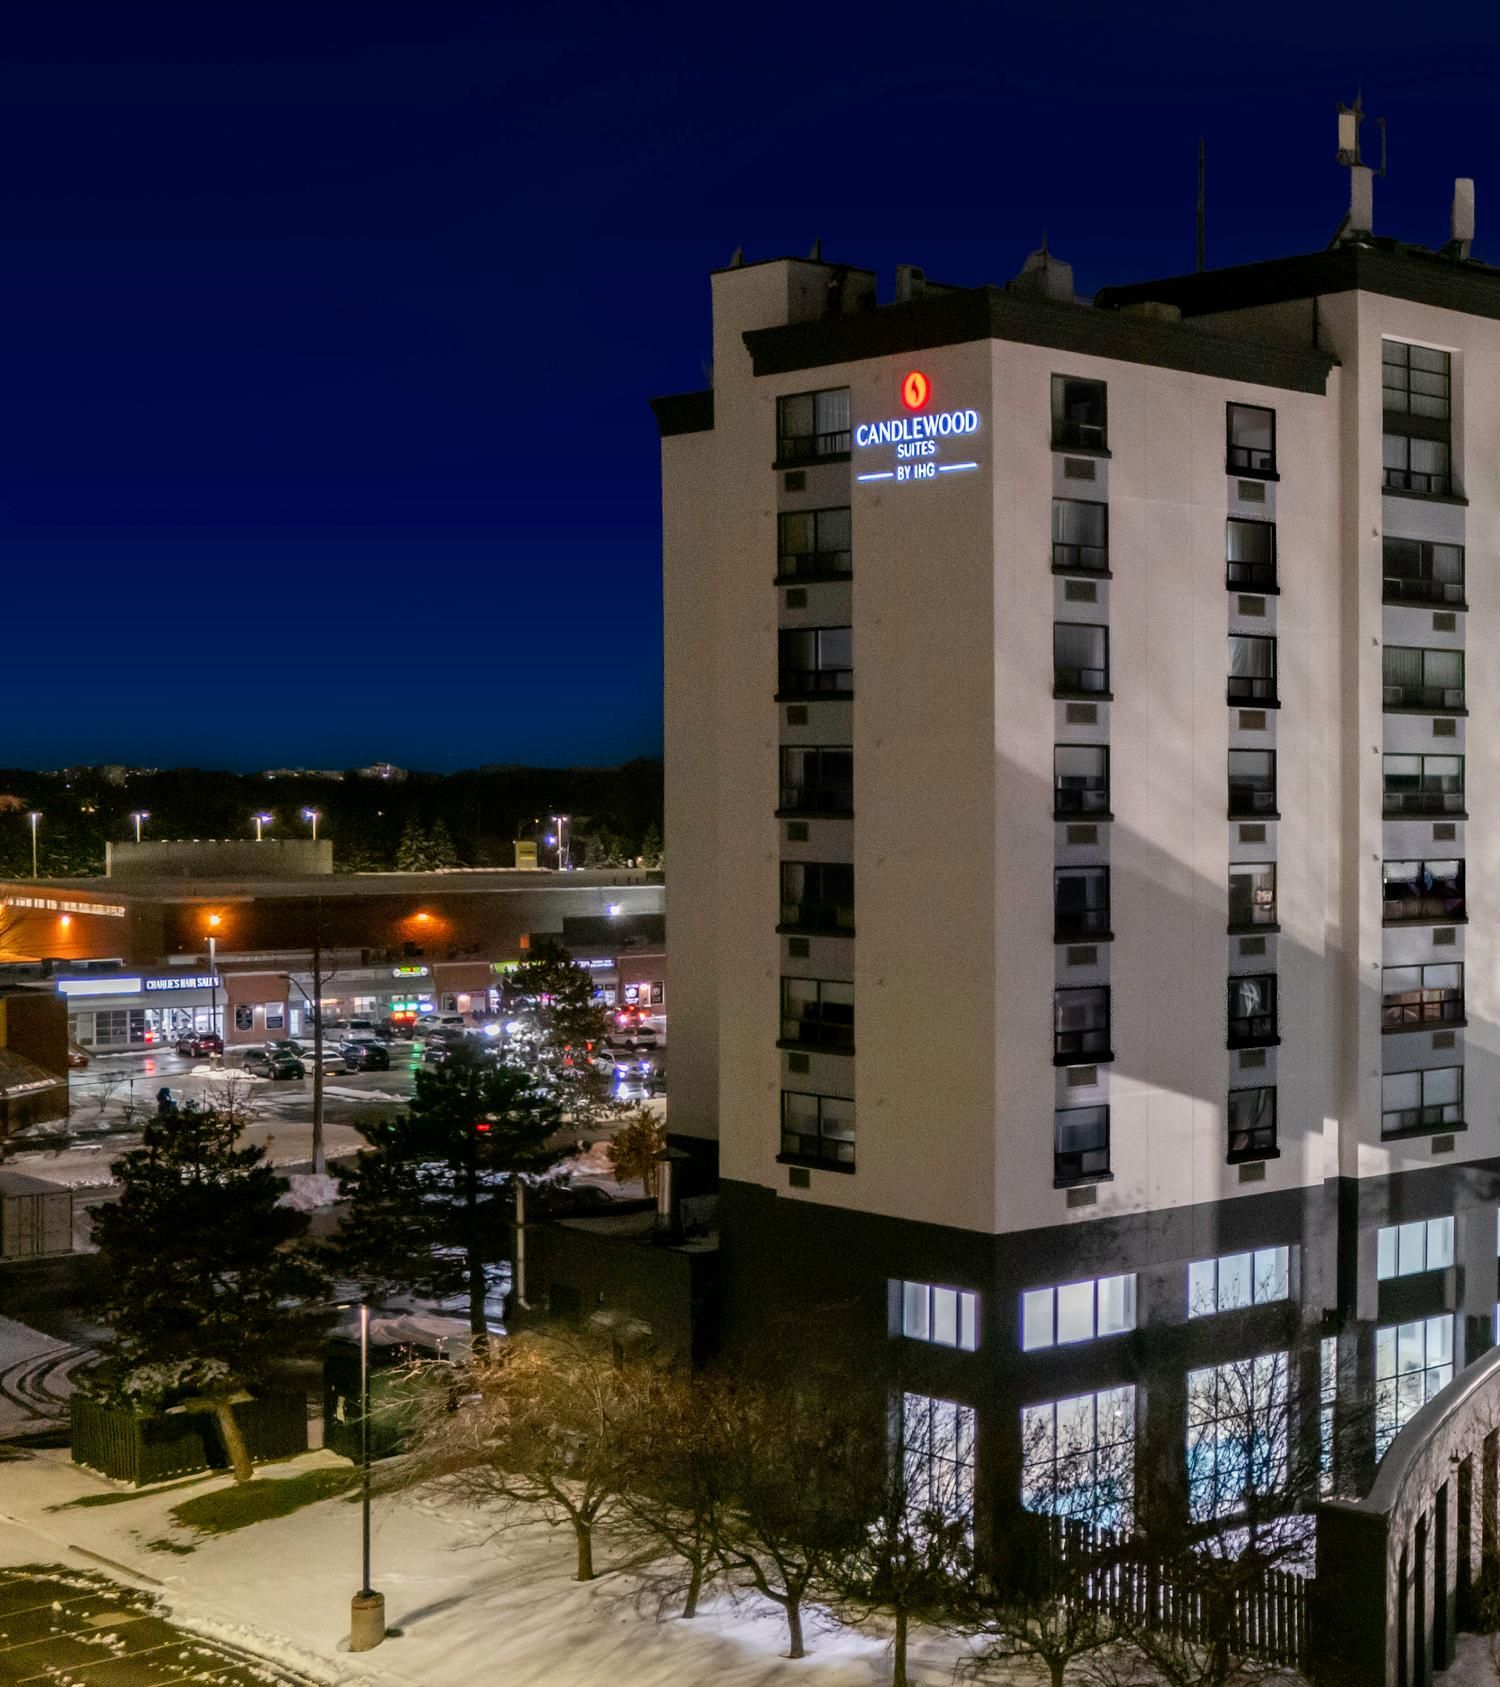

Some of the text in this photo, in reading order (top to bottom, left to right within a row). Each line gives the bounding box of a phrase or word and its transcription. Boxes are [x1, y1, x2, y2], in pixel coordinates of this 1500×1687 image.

[856, 409, 978, 447] CANDLEWOOD
[897, 440, 936, 458] SUITES
[897, 462, 935, 481] BY IHG
[180, 978, 197, 988] HAIR
[197, 976, 219, 987] SALN
